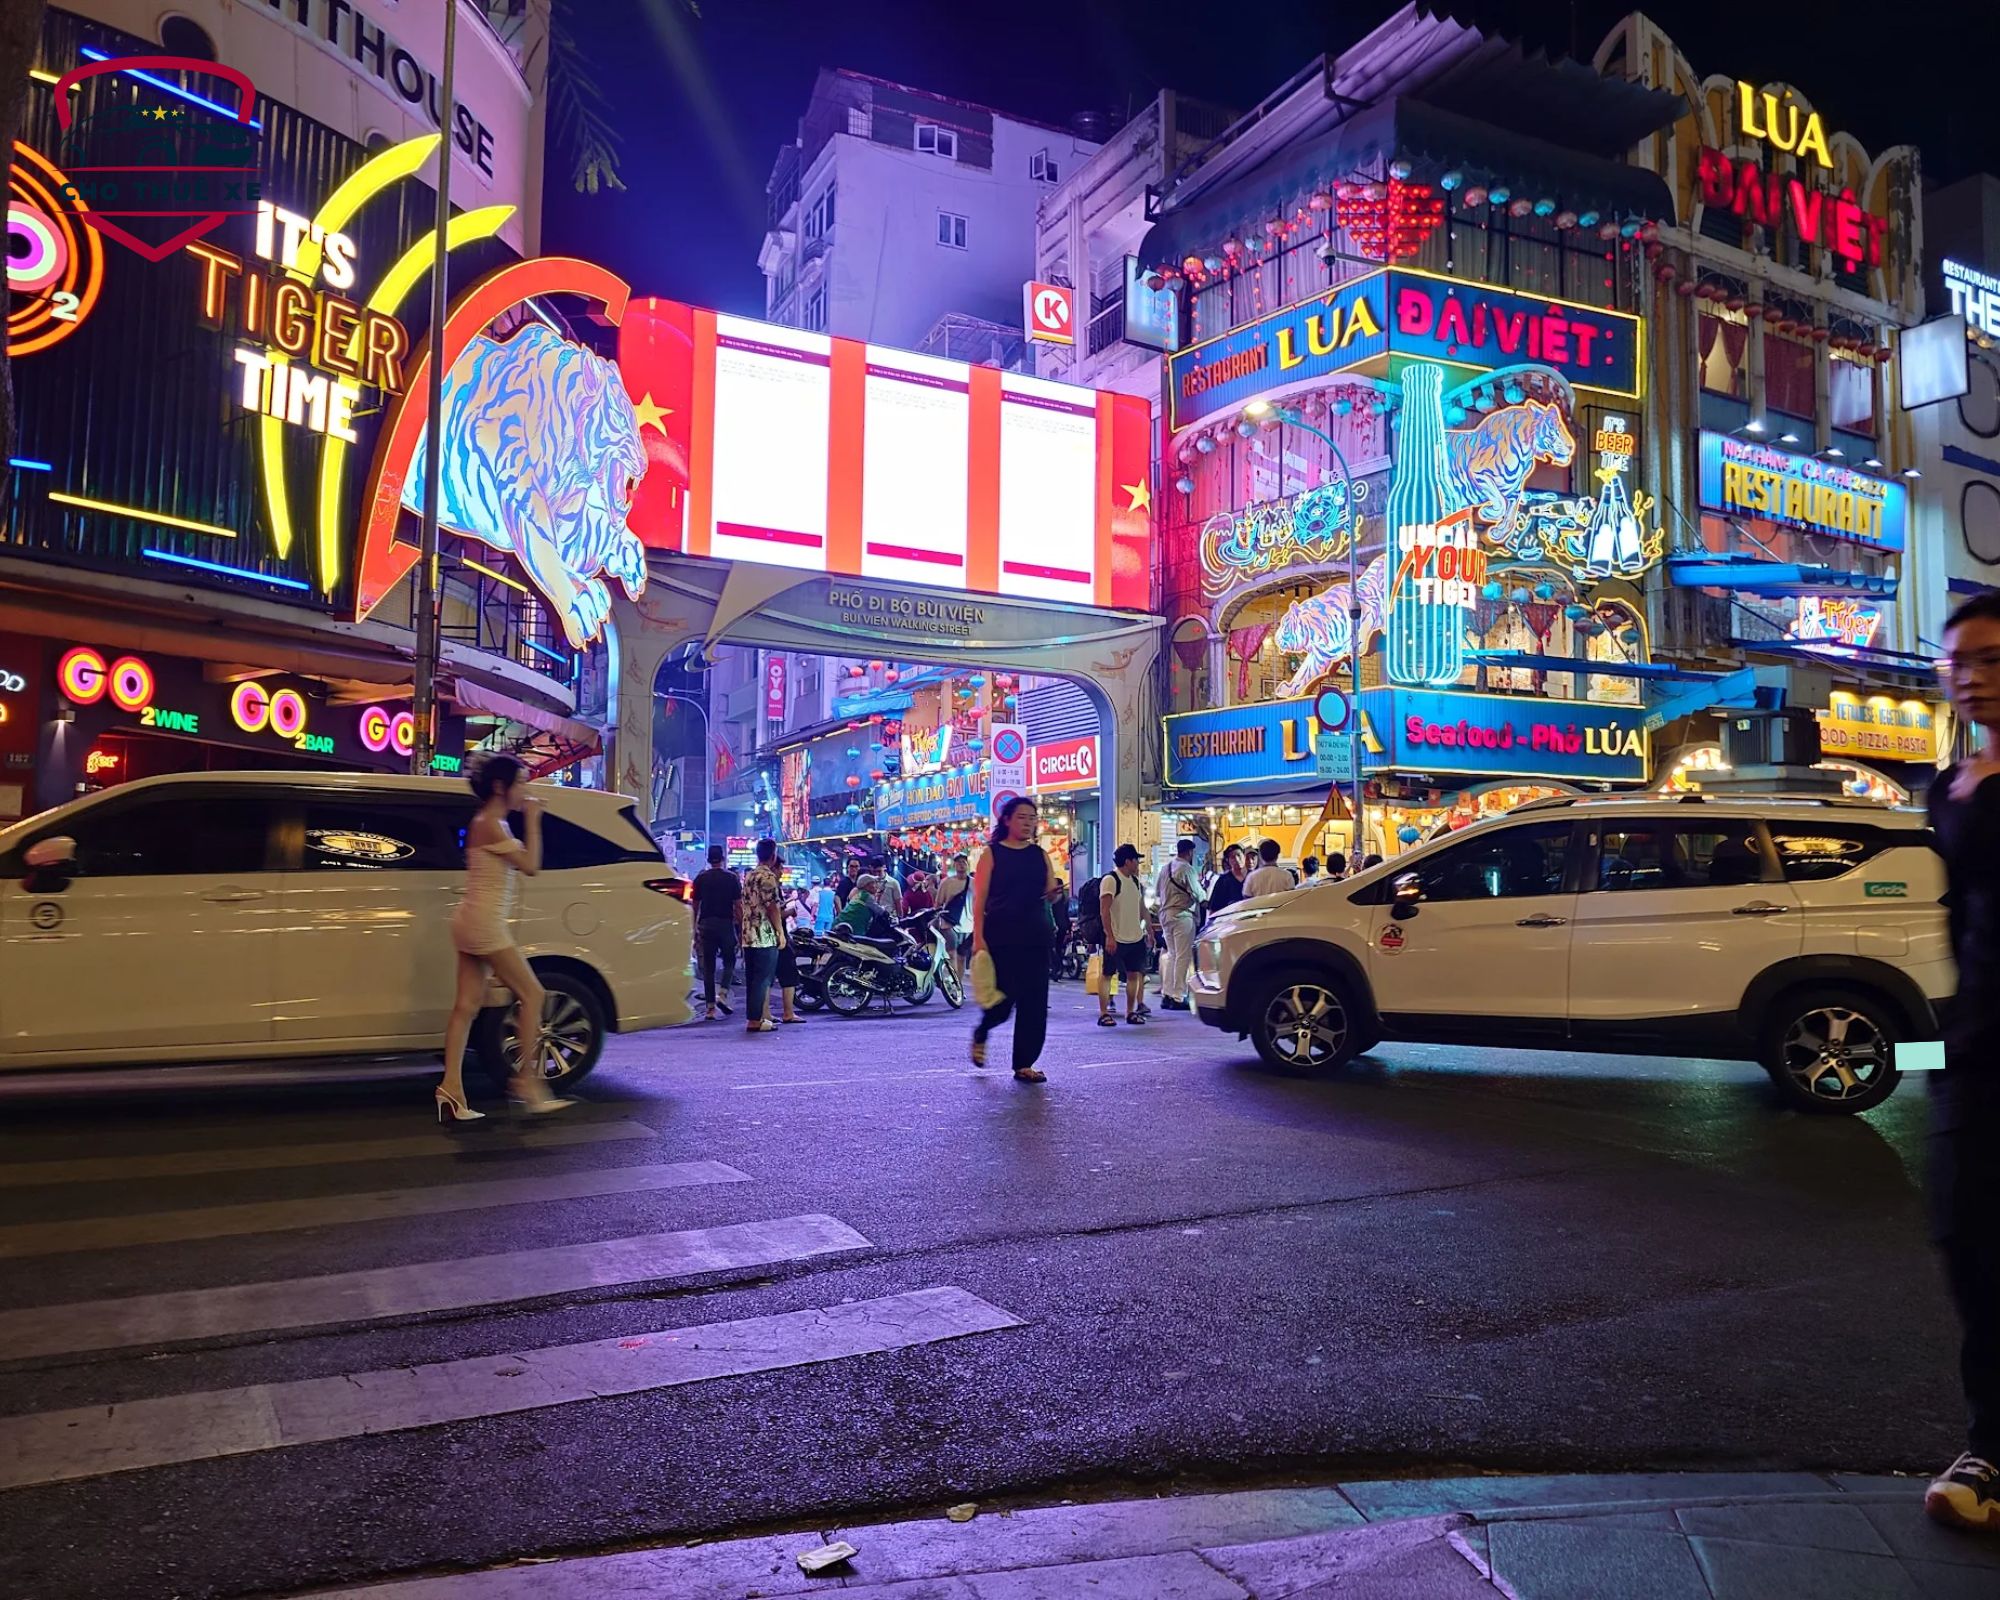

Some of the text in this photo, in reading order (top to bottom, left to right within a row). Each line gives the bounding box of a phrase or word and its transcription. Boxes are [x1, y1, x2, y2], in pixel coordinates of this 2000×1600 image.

[256, 200, 356, 289] IT'S
[186, 240, 409, 396] TIGER
[1183, 293, 1380, 397] RESTAURANT LÚA
[235, 348, 358, 444] TIME
[1595, 430, 1634, 456] BEER
[1603, 416, 1626, 433] IT'S
[1600, 451, 1630, 472] TIME
[1724, 461, 1886, 540] RESTAURANT
[1412, 545, 1487, 586] YOUR
[829, 588, 985, 626] PHỐ ĐI BỘ BÙI VIỆN
[891, 618, 937, 632] WALKING
[939, 625, 973, 637] STREET
[1822, 600, 1875, 644] Tiger
[57, 646, 156, 713] GO
[770, 665, 783, 700] OYO
[231, 681, 307, 738] GO
[1178, 726, 1265, 758] RESTAURANT
[1406, 716, 1513, 750] Seafood
[1584, 722, 1645, 757] LÚA
[1857, 731, 1890, 751] PIZZA
[1896, 735, 1928, 755] PASTA
[1040, 753, 1077, 775] CIRCLE
